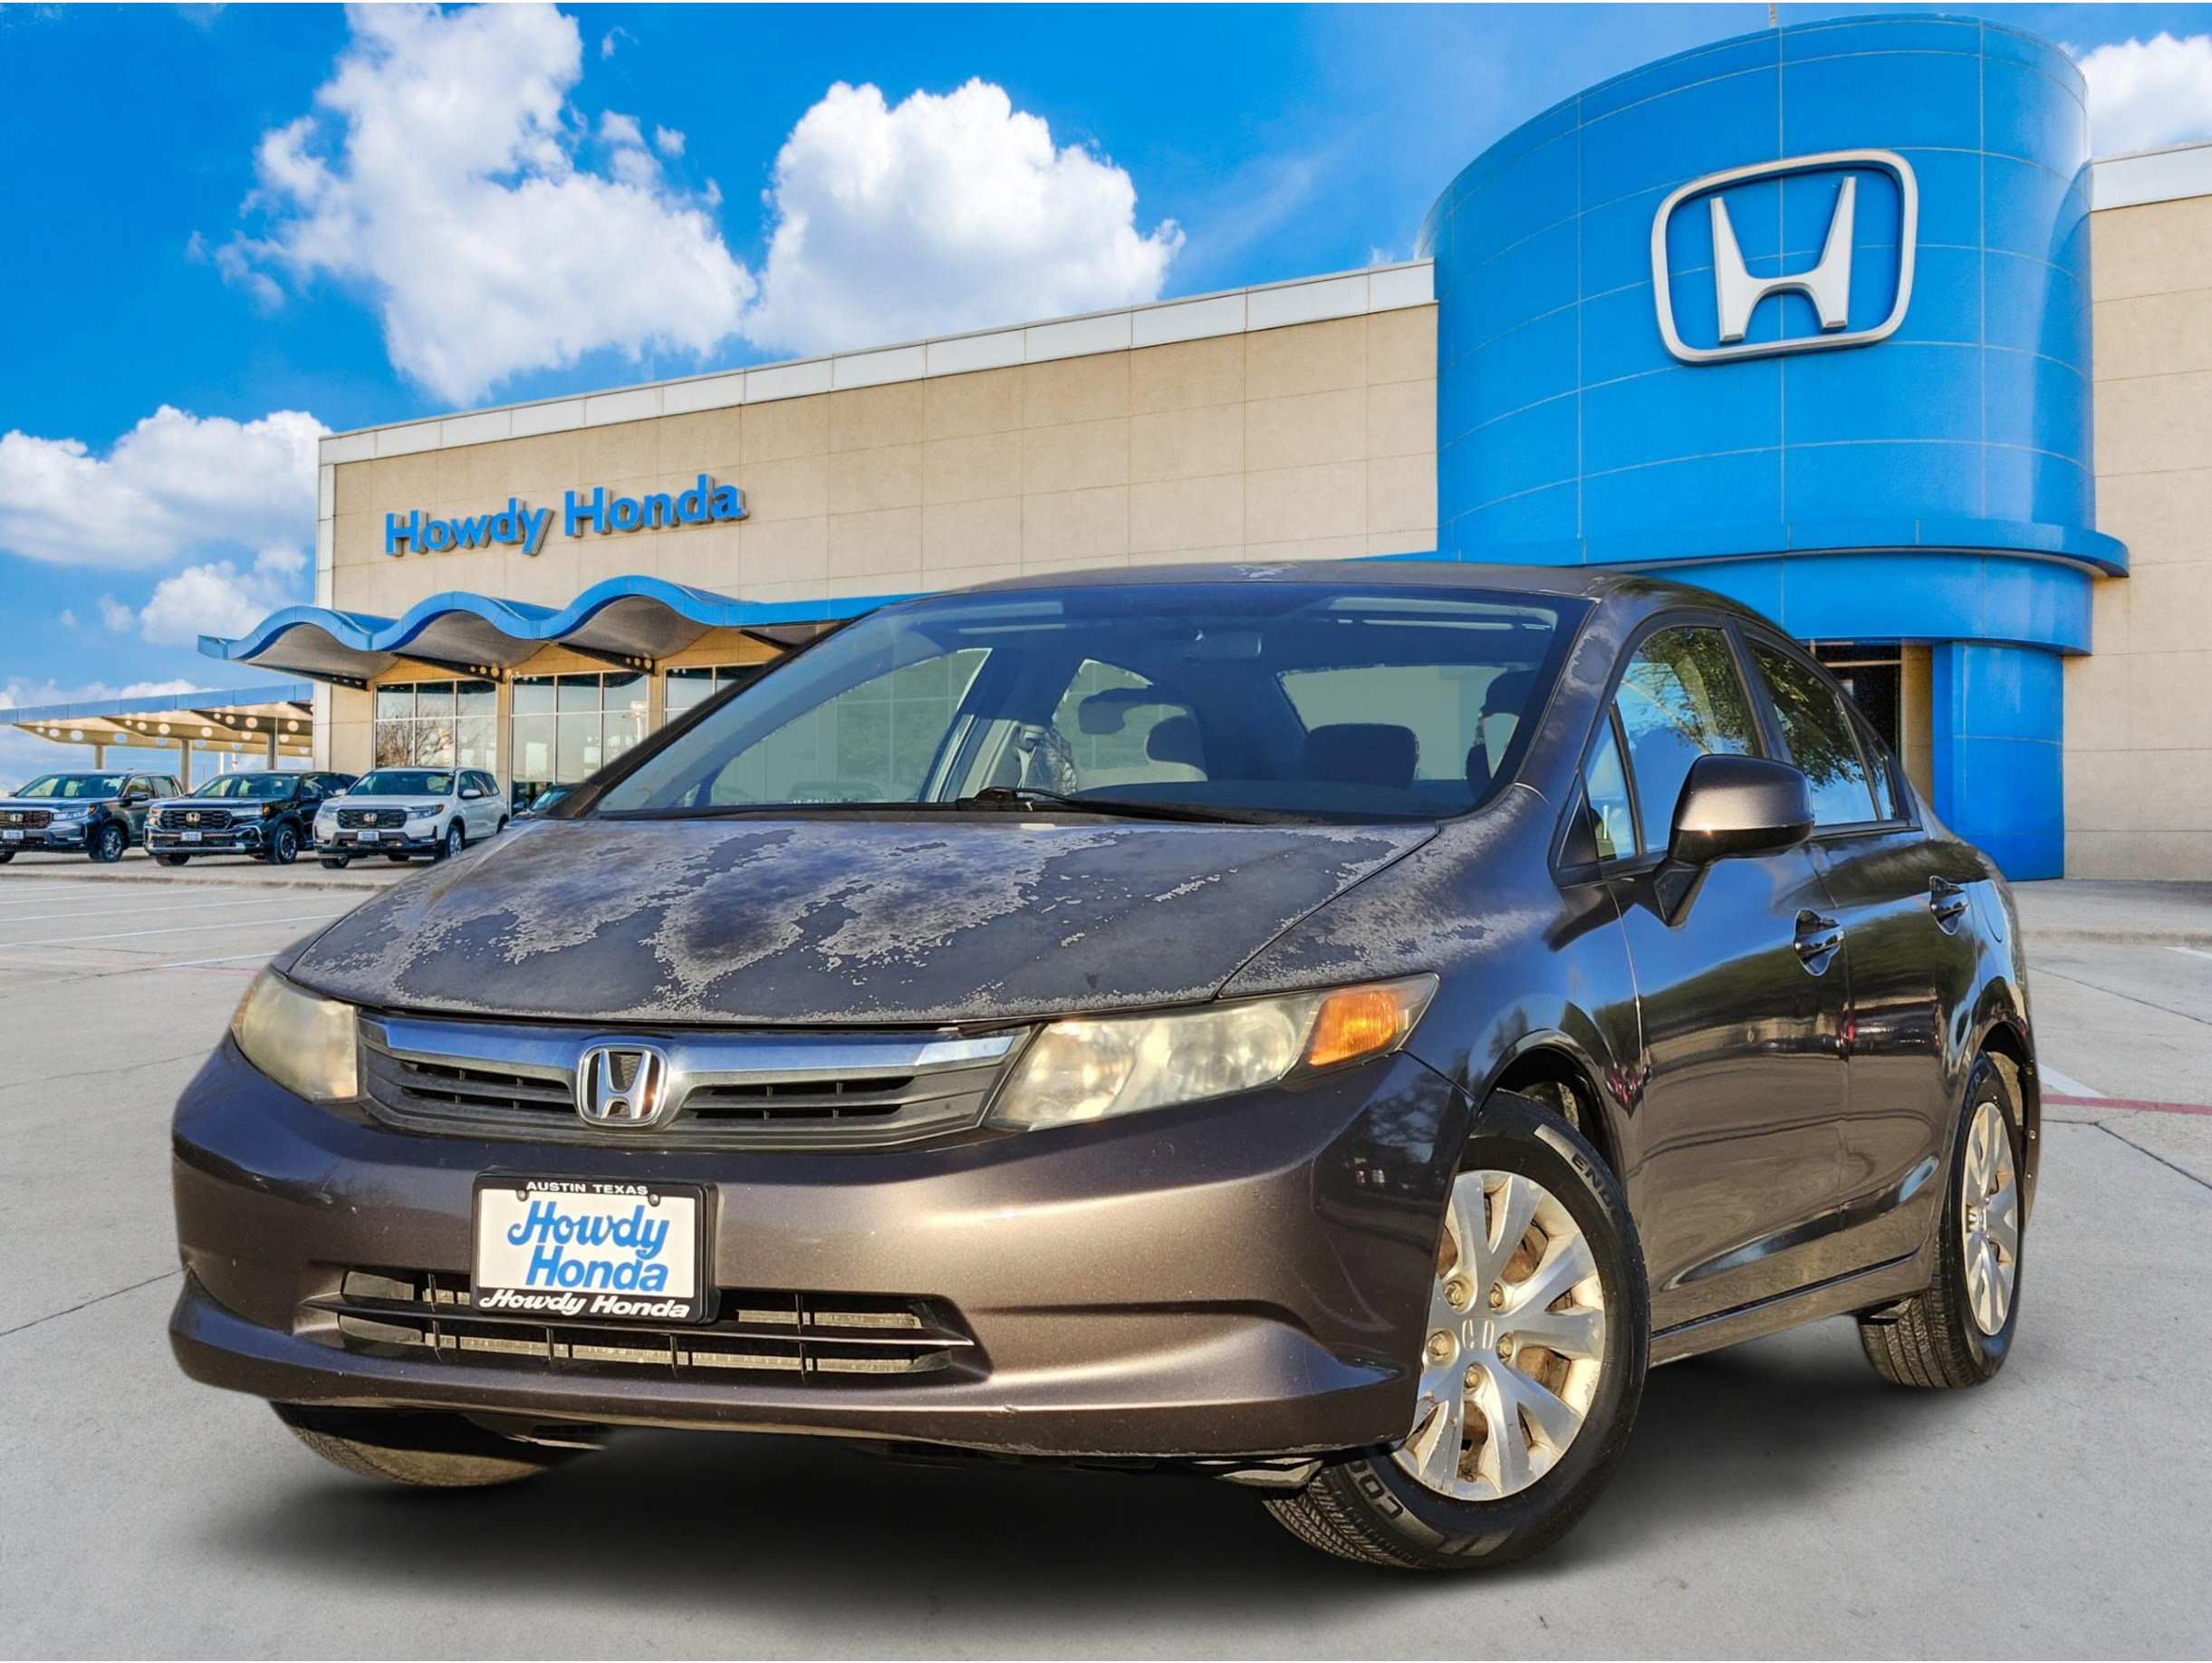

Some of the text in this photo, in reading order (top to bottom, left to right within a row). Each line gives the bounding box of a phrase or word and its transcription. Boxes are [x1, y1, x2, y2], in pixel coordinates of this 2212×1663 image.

[385, 474, 749, 557] Howdy Honda
[525, 1180, 649, 1197] AUSTIN TEXAS
[506, 1200, 670, 1260] Howdy
[524, 1245, 668, 1293] Honda
[478, 1289, 690, 1319] Howdy Honda
